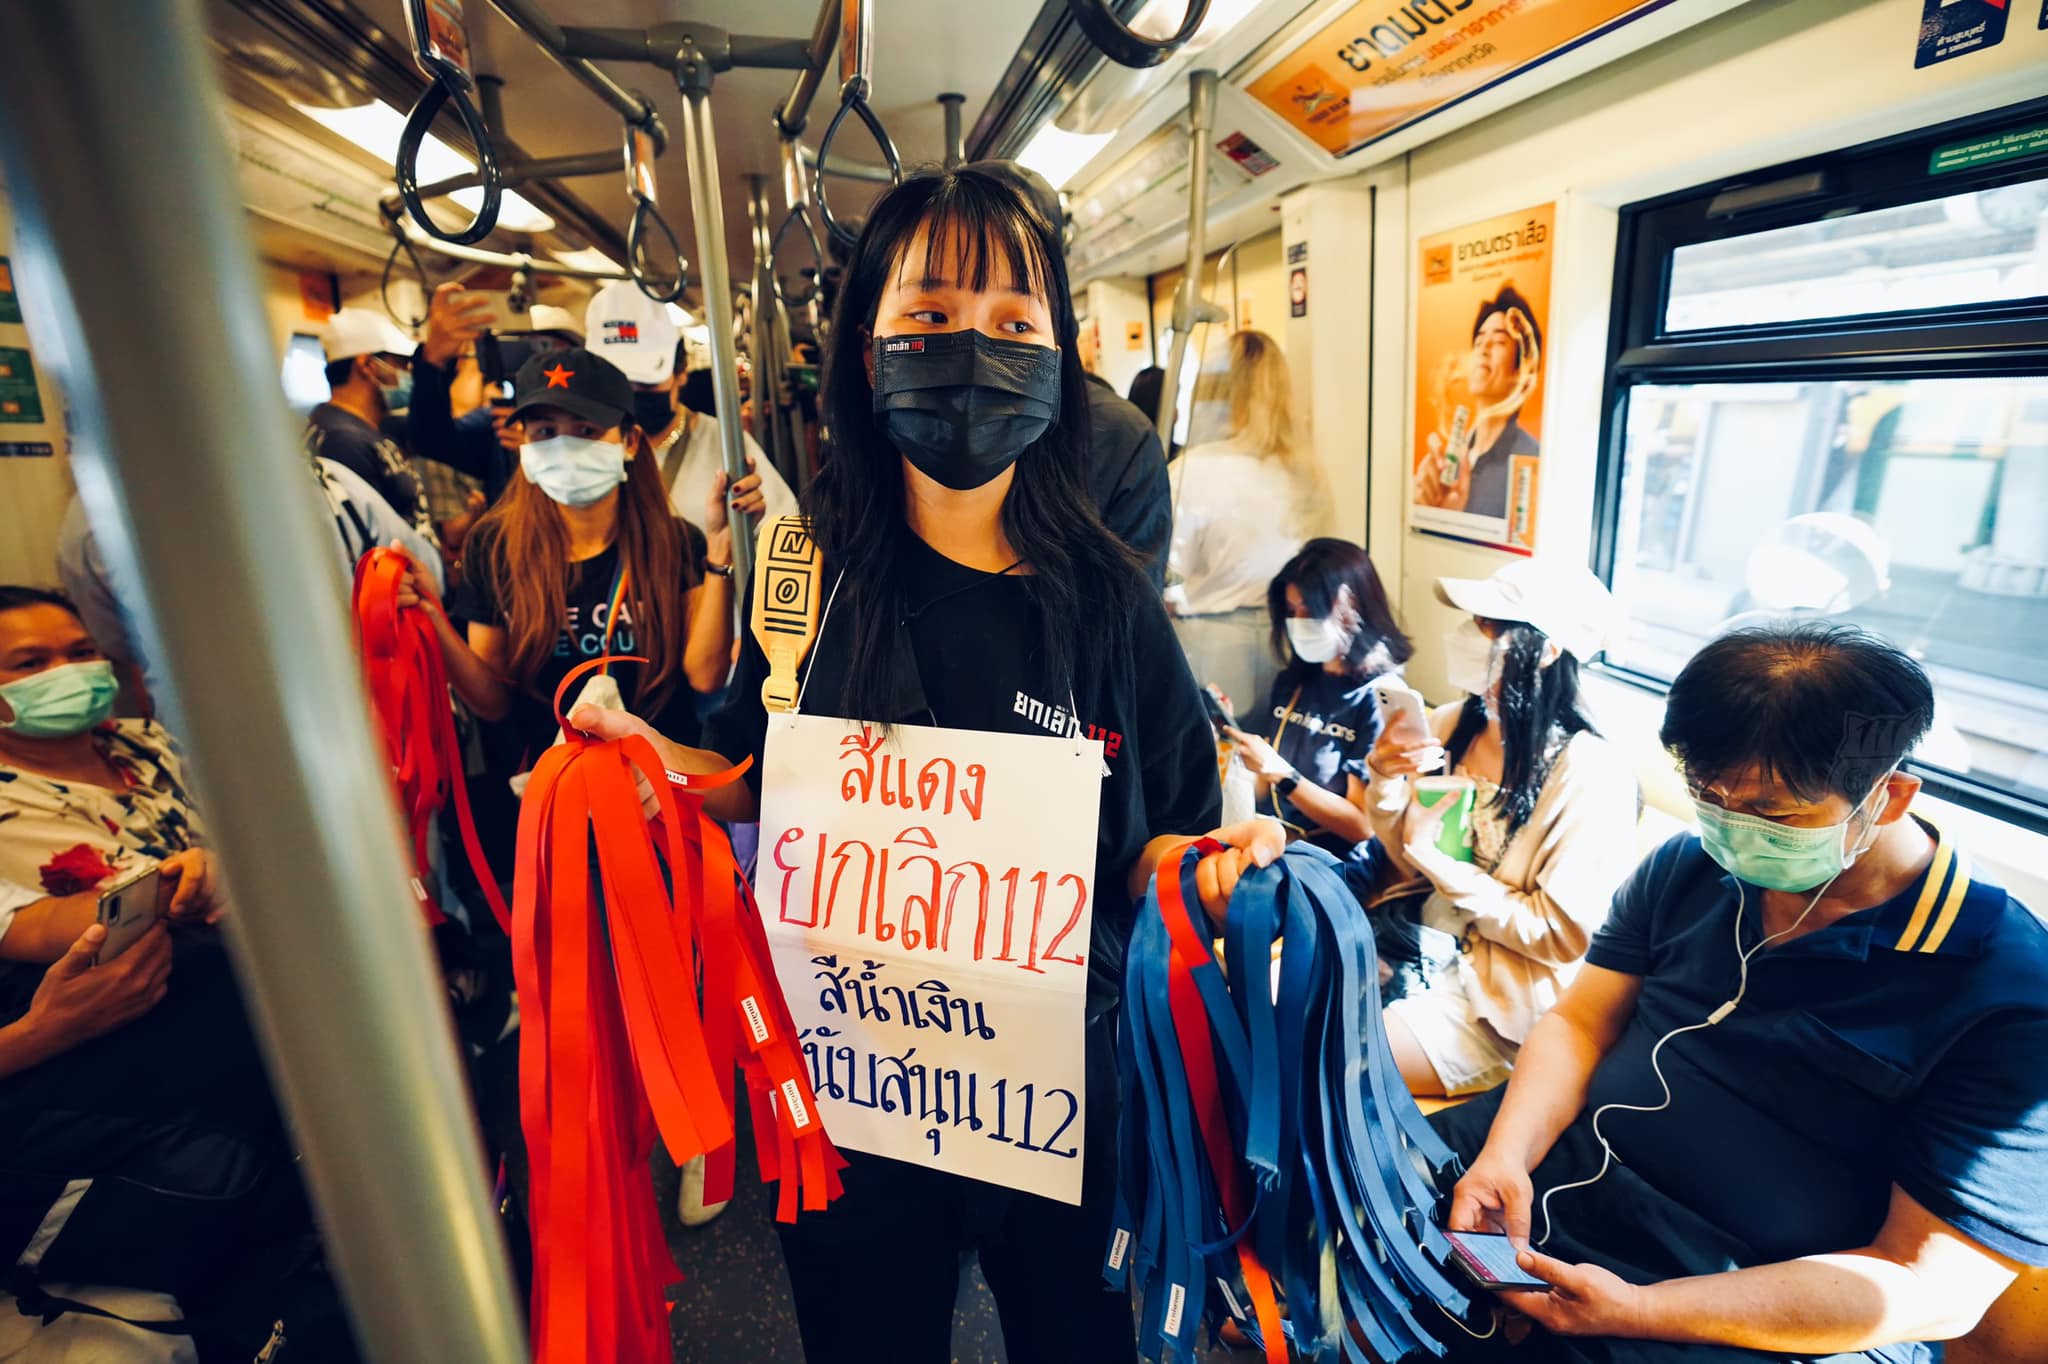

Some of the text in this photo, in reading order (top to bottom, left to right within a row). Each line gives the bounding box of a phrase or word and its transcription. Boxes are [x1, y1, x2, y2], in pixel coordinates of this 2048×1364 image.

[1337, 0, 1475, 73] ยาดมต
[1457, 219, 1547, 262] ยาดมตราเสือ
[1013, 690, 1123, 759] ยกเลิก 112
[839, 724, 987, 822] สีแดง
[810, 954, 996, 1041] สีน้ำเงิน
[799, 1026, 1082, 1158] นับสนุน112
